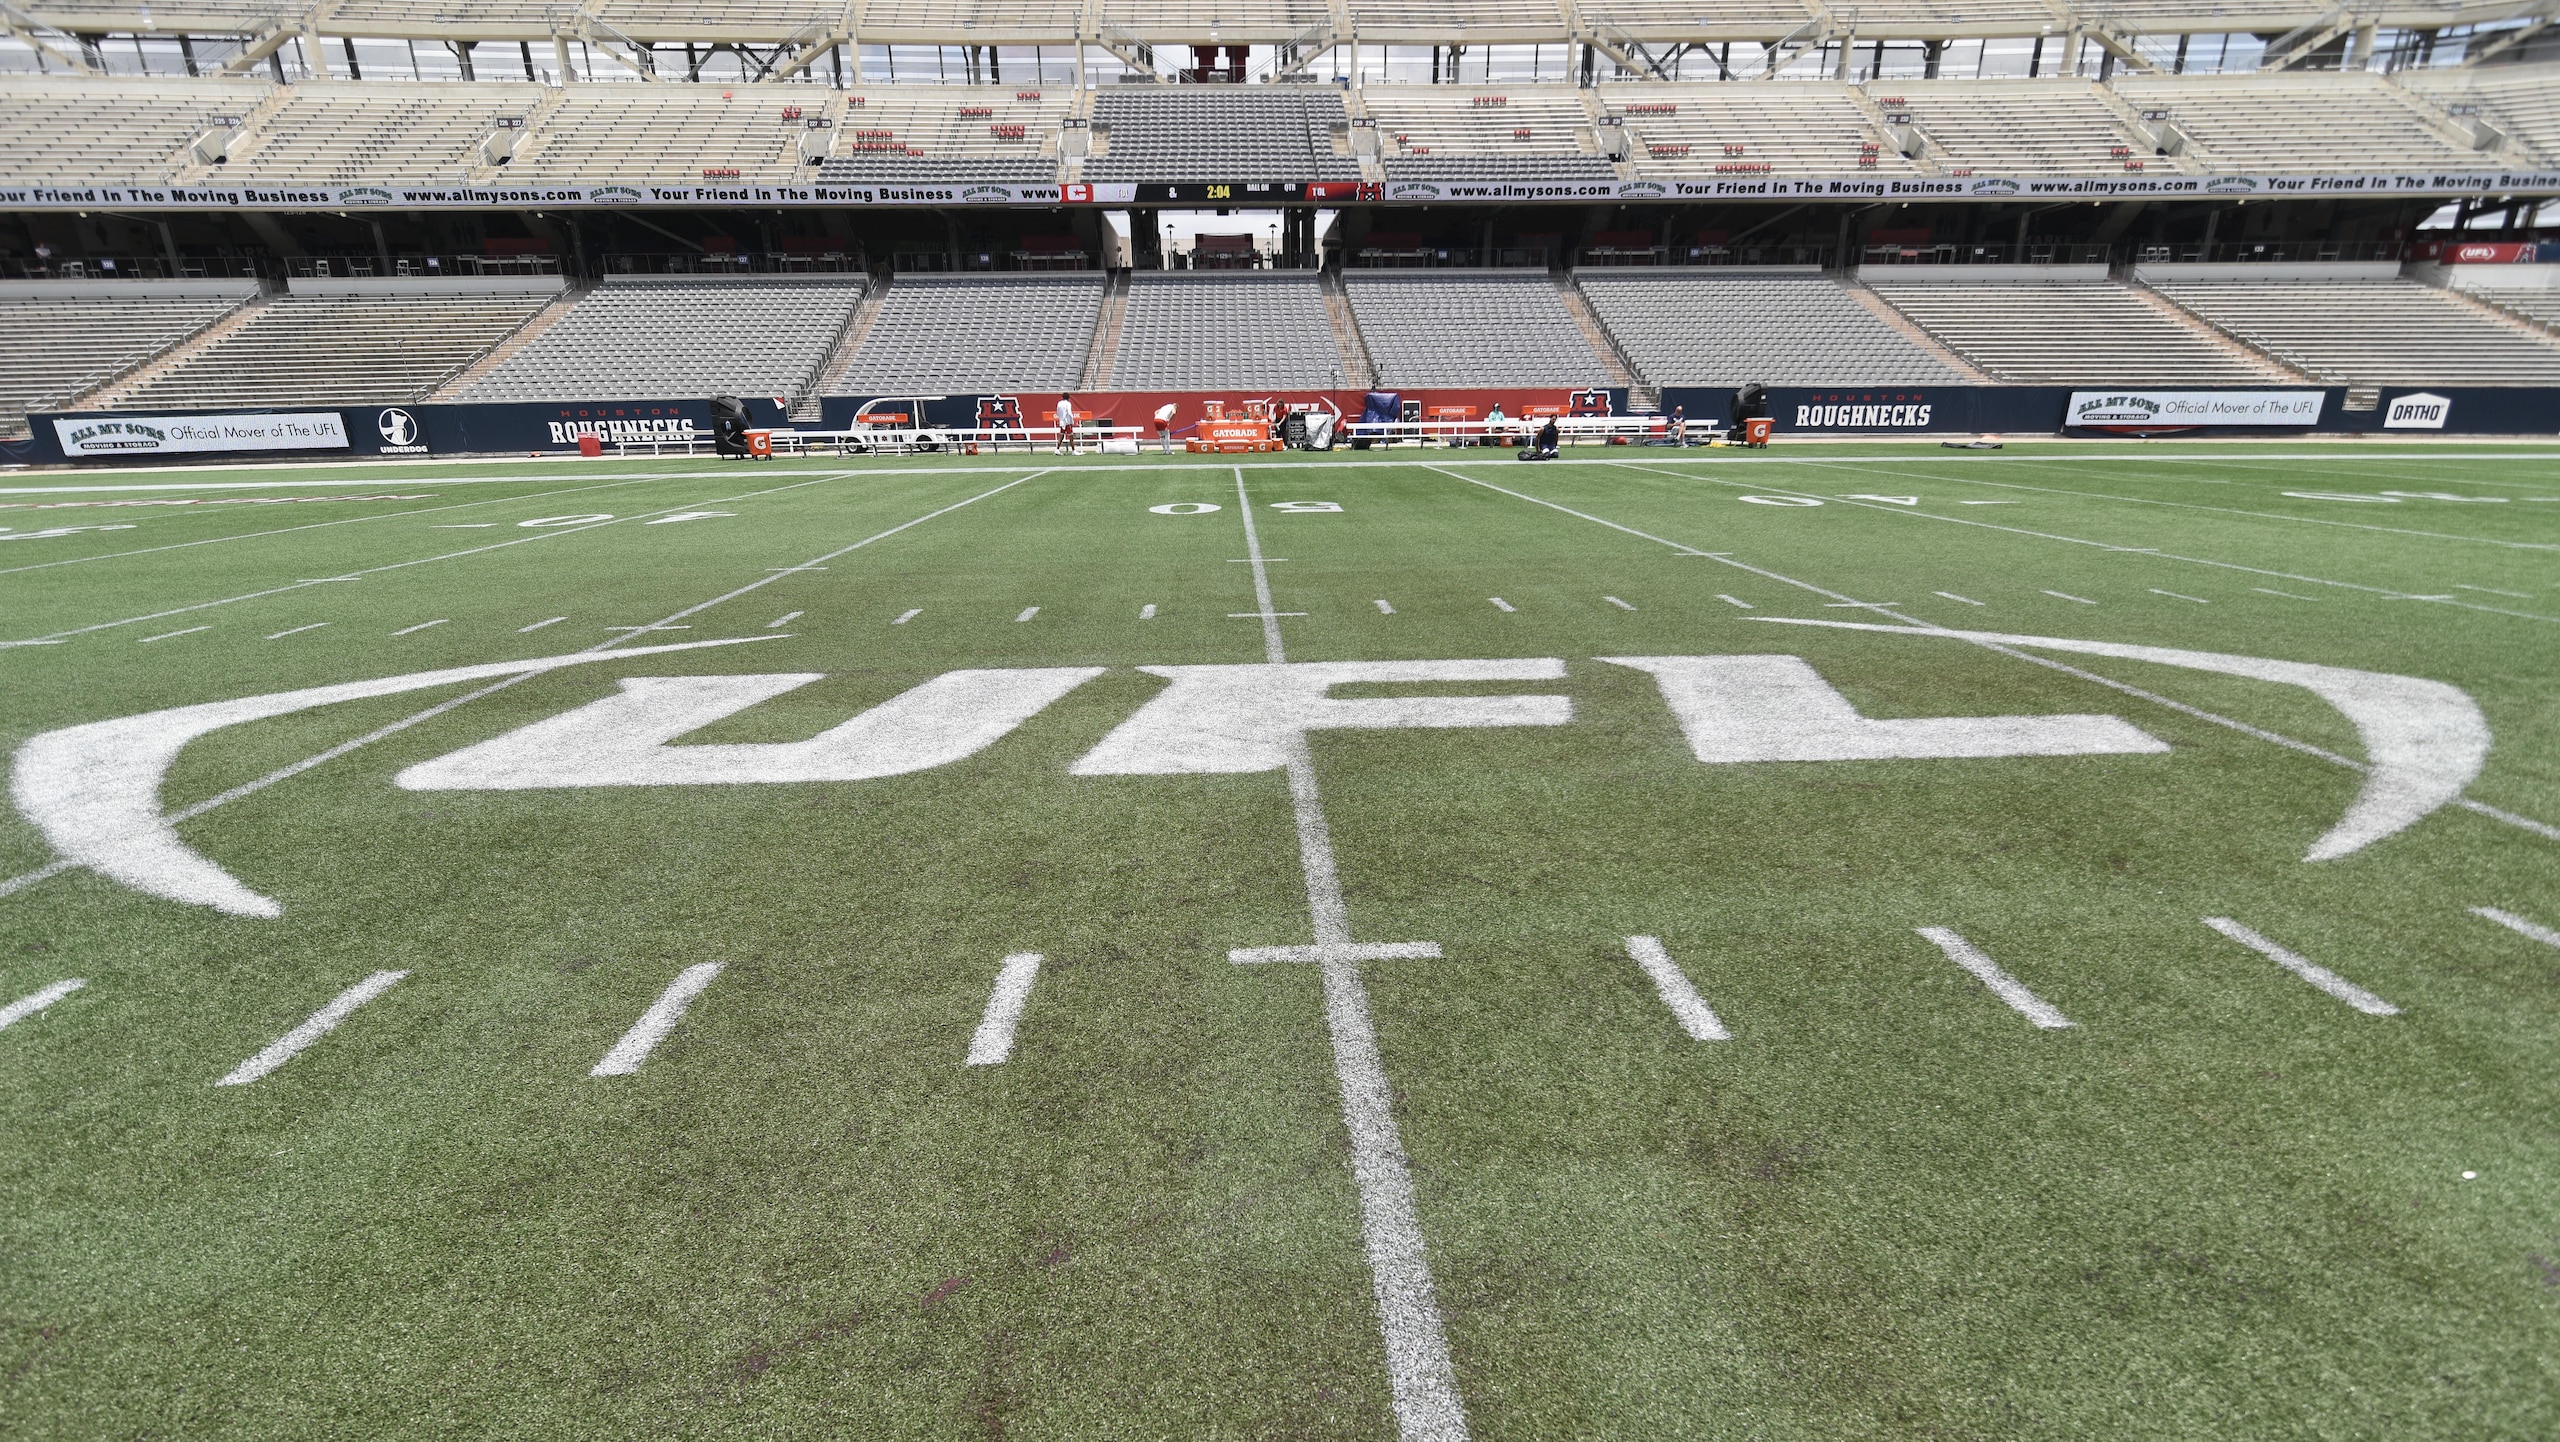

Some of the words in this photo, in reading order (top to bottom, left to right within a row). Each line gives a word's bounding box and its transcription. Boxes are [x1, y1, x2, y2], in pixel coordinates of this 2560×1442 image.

[1676, 183, 1710, 194] Your
[1716, 182, 1766, 194] Friend
[1772, 182, 1787, 194] In
[1794, 182, 1823, 194] The
[1829, 182, 1884, 196] Moving
[1890, 180, 1962, 194] Business
[2030, 180, 2198, 194] www.allmysons.com
[2268, 178, 2305, 190] Your
[2310, 178, 2364, 190] Friend
[2370, 178, 2387, 189] In
[2394, 176, 2424, 188] The
[2432, 176, 2492, 190] Moving
[33, 189, 96, 202] Friend
[102, 189, 120, 202] In
[128, 189, 164, 202] The
[171, 189, 239, 205] Moving
[245, 189, 329, 202] Business
[403, 189, 582, 204] www.allmysons.com
[650, 188, 688, 200] Your
[695, 188, 749, 200] Friend
[755, 188, 770, 200] In
[777, 188, 808, 200] The
[814, 188, 873, 203] Moving
[880, 188, 952, 200] Business
[1169, 187, 1177, 198] &
[1207, 186, 1230, 198] 2:04
[1312, 187, 1326, 197] TOL
[1450, 184, 1610, 198] www.allmysons.com
[2466, 248, 2490, 257] UFL
[561, 408, 679, 416] HOUSTON
[2077, 400, 2103, 415] ALL
[2105, 397, 2128, 408] MY
[2128, 397, 2160, 415] SONS
[2165, 401, 2209, 414] Official
[2212, 402, 2252, 414] Mover
[2253, 401, 2267, 414] of
[2269, 401, 2291, 414] The
[2292, 401, 2314, 414] UFL
[2392, 404, 2440, 422] ORTHO
[1795, 404, 1932, 427] ROUGHNECKS
[70, 425, 98, 444] ALL
[100, 423, 123, 436] MY
[126, 423, 166, 442] SONS
[171, 425, 220, 440] Official
[224, 426, 266, 438] Mover
[271, 424, 284, 437] of
[286, 424, 310, 436] The
[313, 424, 338, 436] UFL
[548, 418, 695, 444] ROUGHNECKS
[1212, 428, 1258, 438] GATORADE
[1753, 424, 1767, 438] G
[82, 442, 114, 450] MOVING
[380, 445, 428, 454] UNDERDOG
[754, 436, 766, 450] G
[1200, 444, 1208, 452] G
[1259, 443, 1266, 452] G
[397, 655, 2172, 790] UFL
